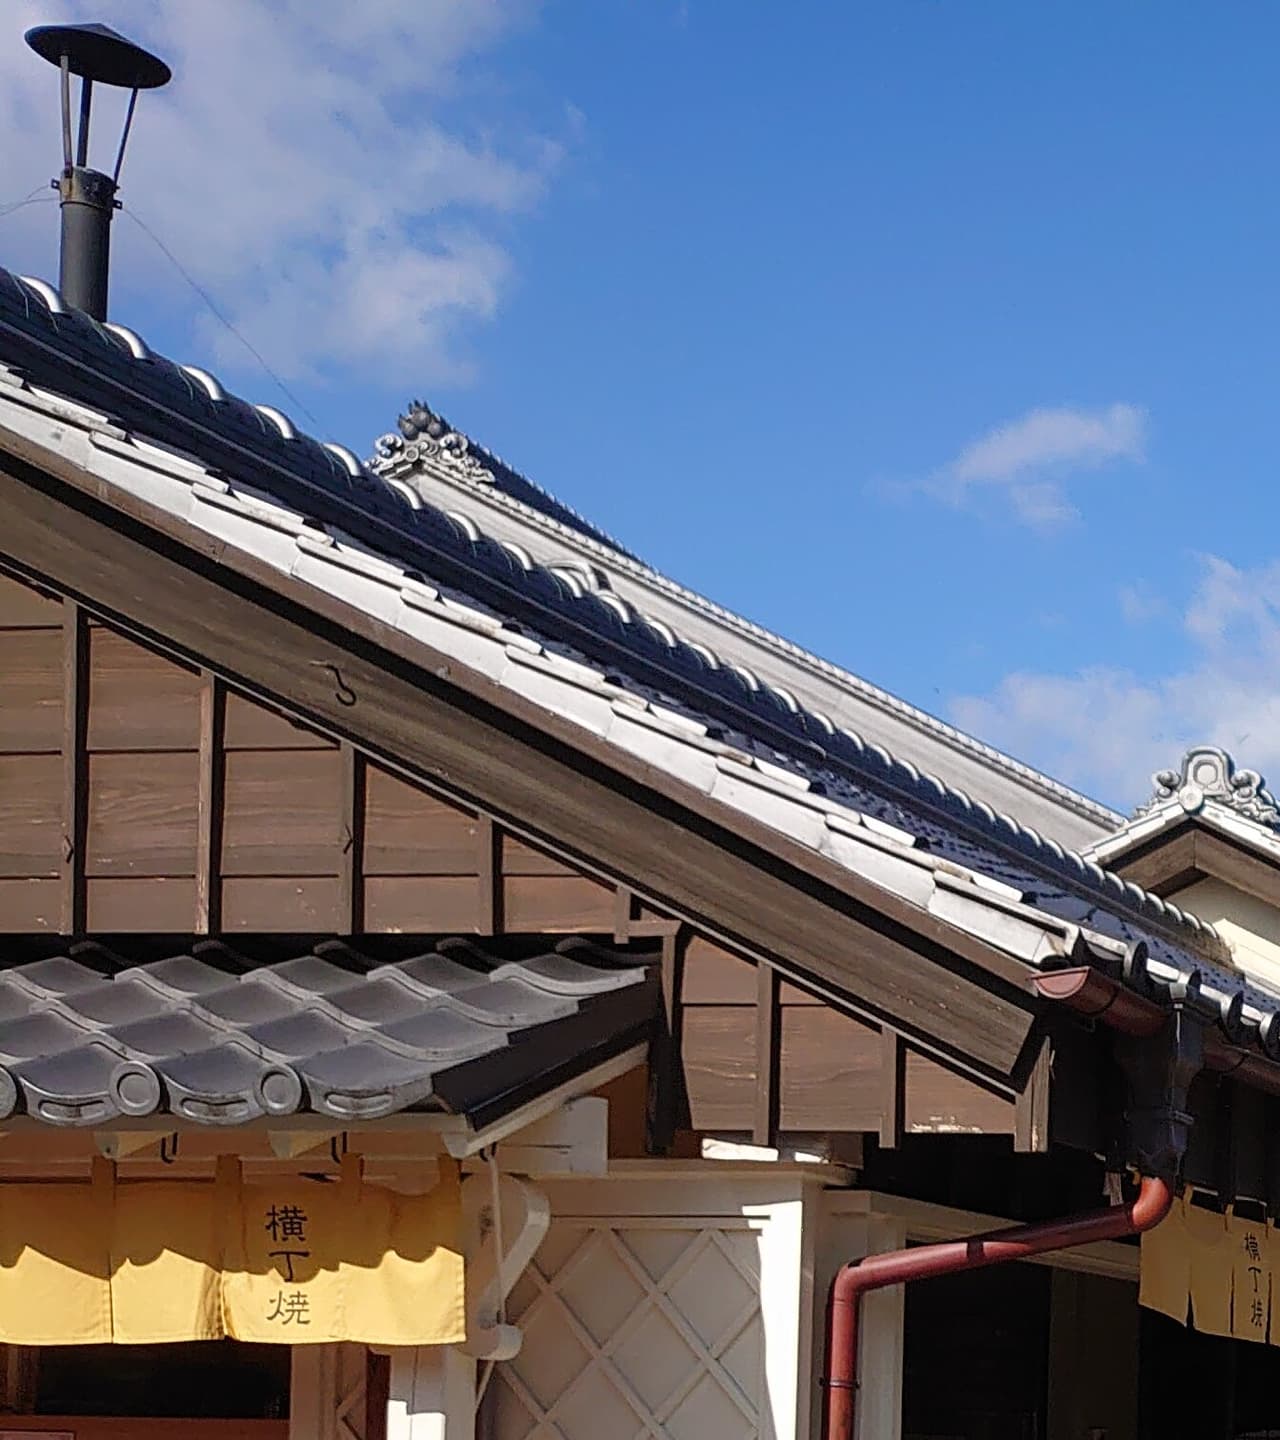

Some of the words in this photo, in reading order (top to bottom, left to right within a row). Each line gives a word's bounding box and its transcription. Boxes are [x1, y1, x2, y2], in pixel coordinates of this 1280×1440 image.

[265, 1204, 311, 1325] 横丁焼
[1244, 1231, 1264, 1328] 横丁焼
